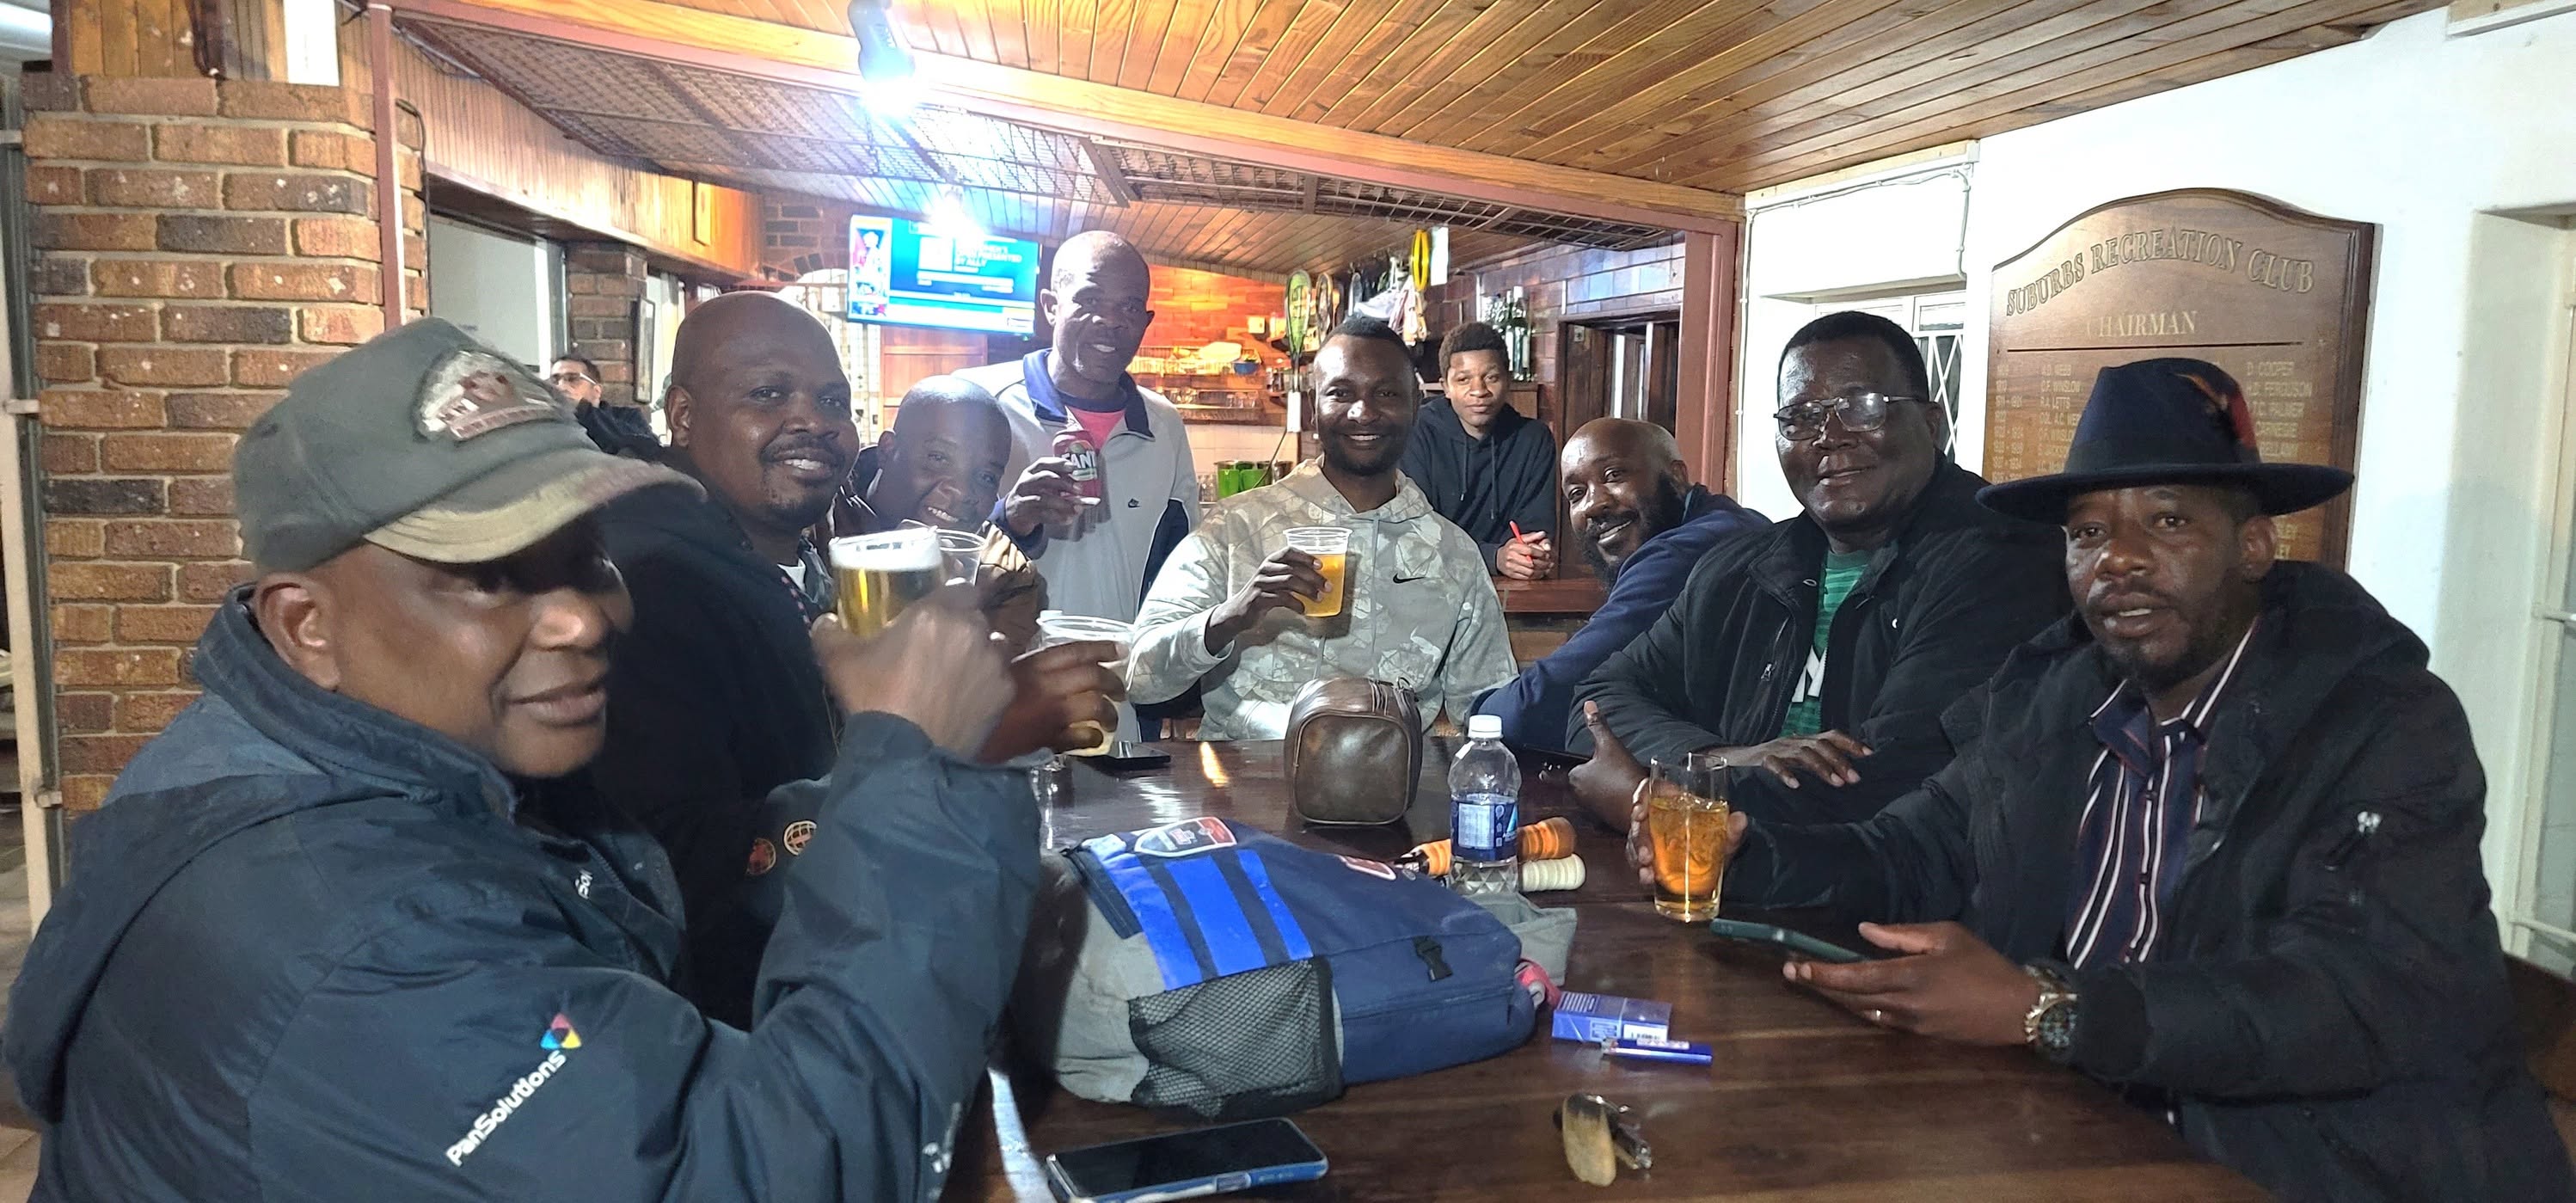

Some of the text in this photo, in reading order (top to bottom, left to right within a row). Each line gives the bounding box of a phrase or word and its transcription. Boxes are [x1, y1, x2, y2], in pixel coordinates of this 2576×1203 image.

[2006, 225, 2315, 316] SUBURBS RECREATION CLUB
[2086, 310, 2199, 339] CHAIRMAN
[445, 1049, 567, 1168] PanSolutions
